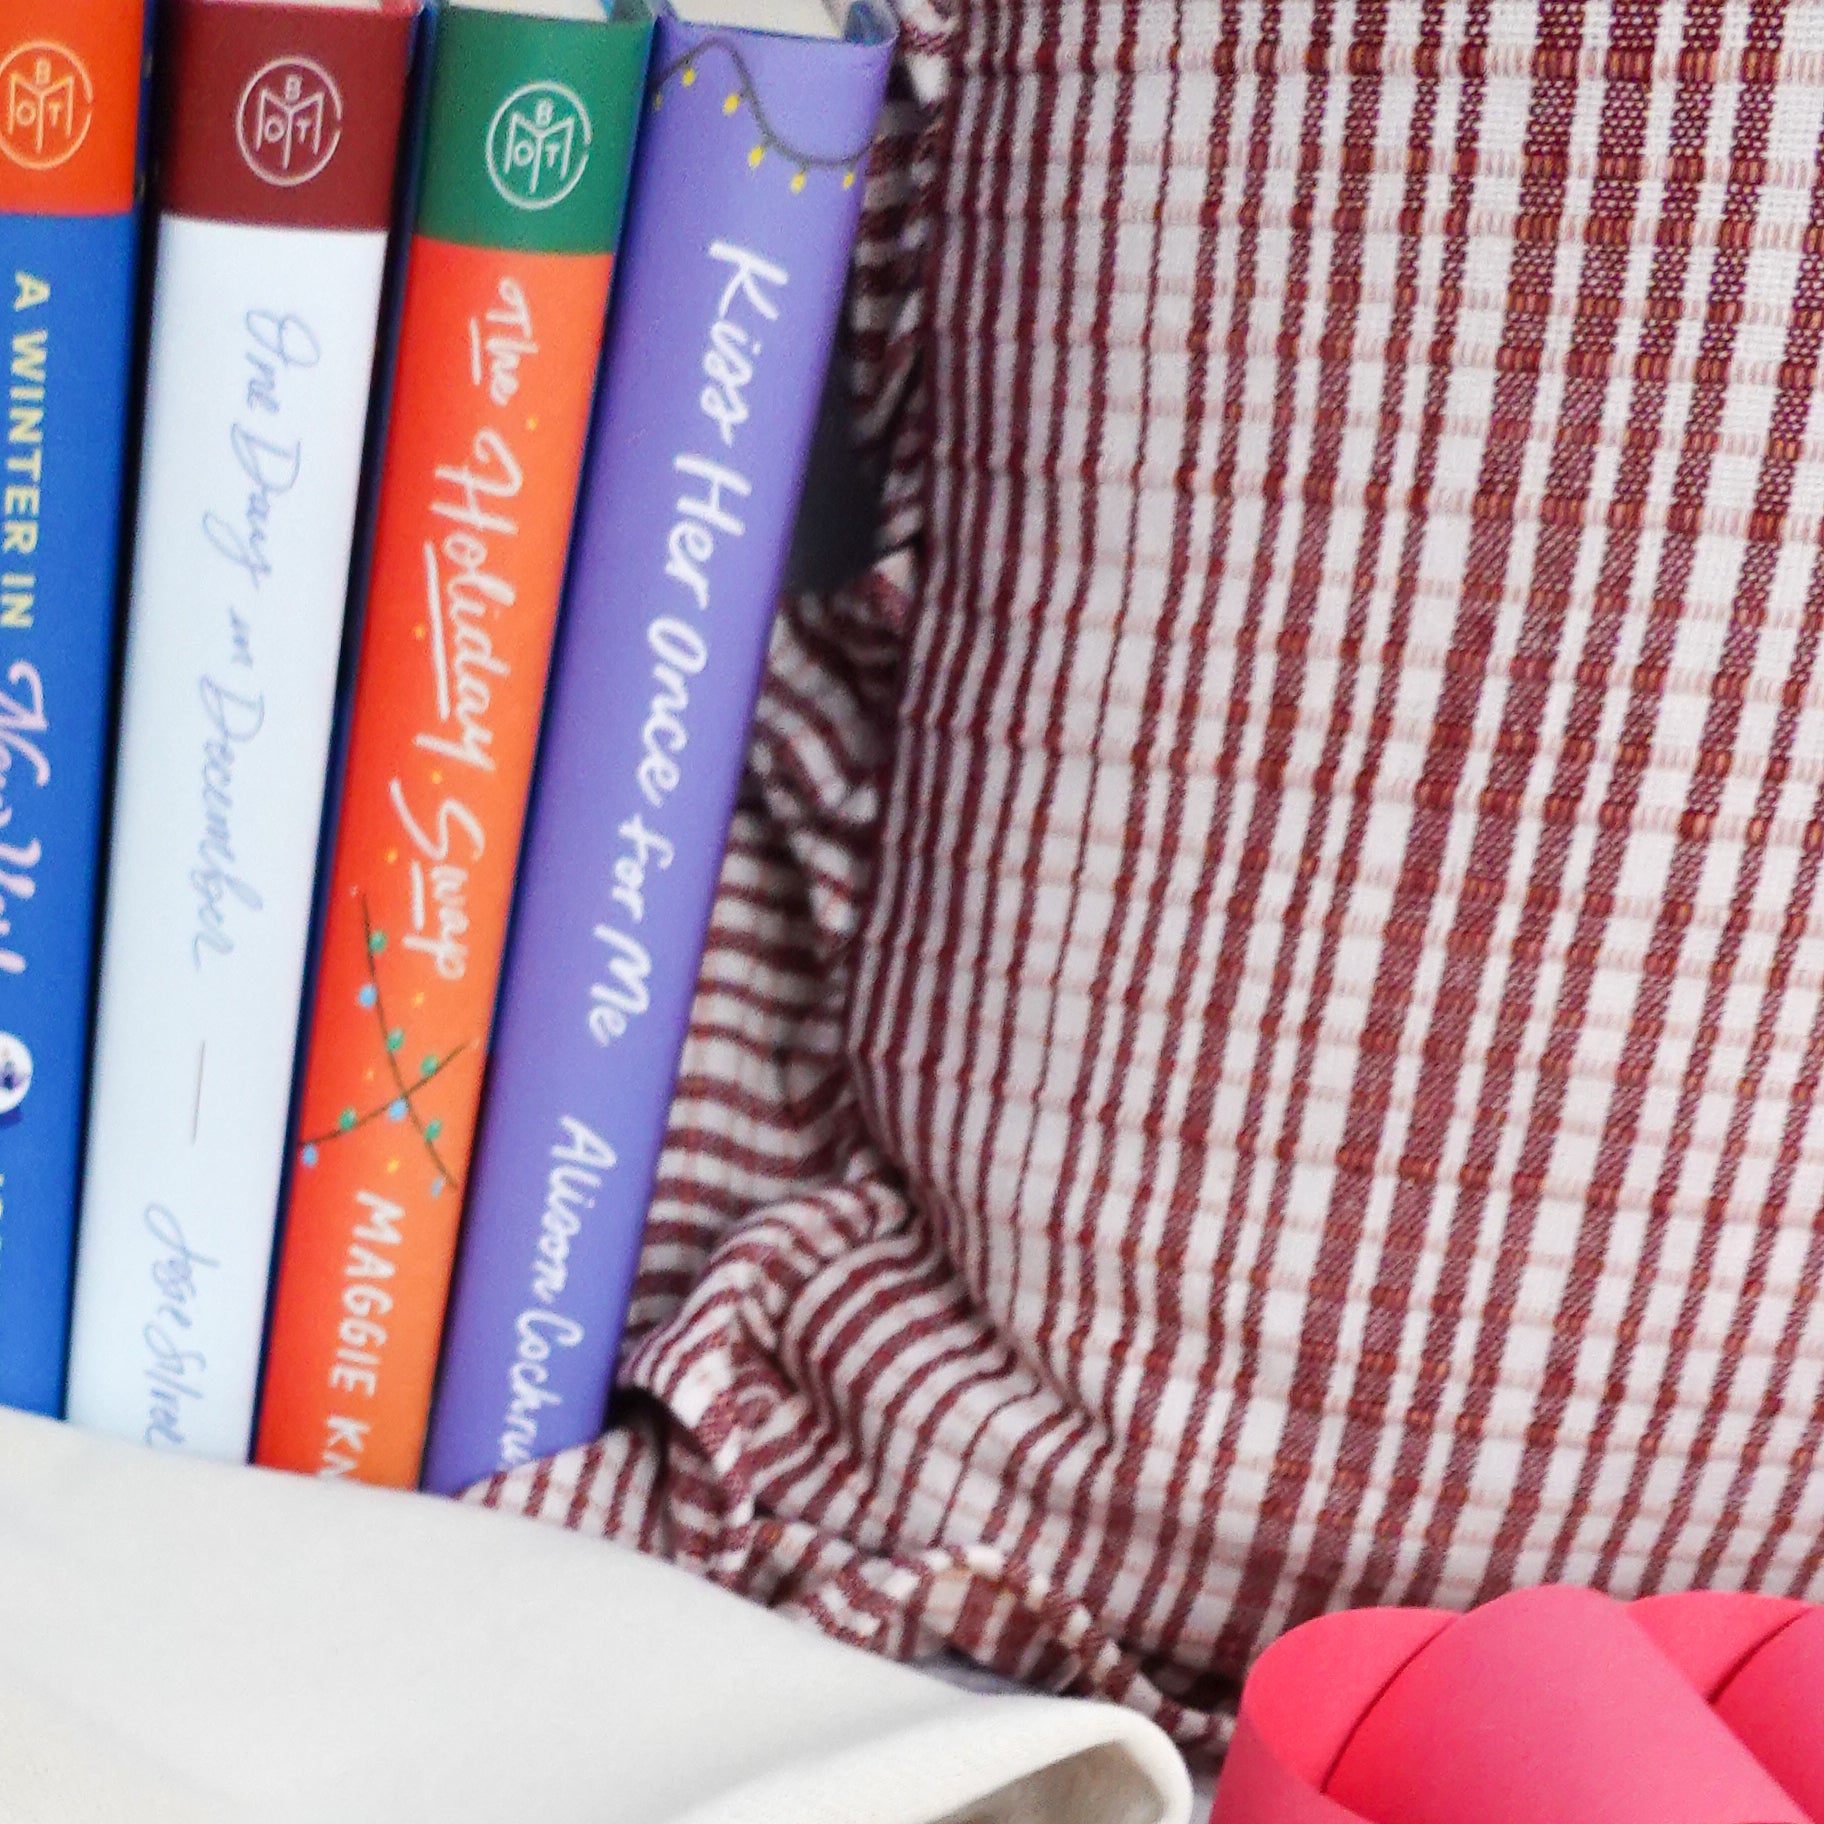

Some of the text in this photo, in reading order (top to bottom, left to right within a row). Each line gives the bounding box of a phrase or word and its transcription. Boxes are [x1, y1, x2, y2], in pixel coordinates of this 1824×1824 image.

[13, 272, 51, 312] A
[246, 310, 320, 416] One
[1, 330, 49, 556] WINTER
[202, 423, 300, 590] Day
[0, 573, 38, 631] IN
[389, 276, 540, 980] The Holiday Swap
[589, 239, 789, 1047] Kiss Her Once for Me
[189, 673, 265, 973] December
[331, 1189, 406, 1401] MAGGIE
[534, 1113, 618, 1305] Alison
